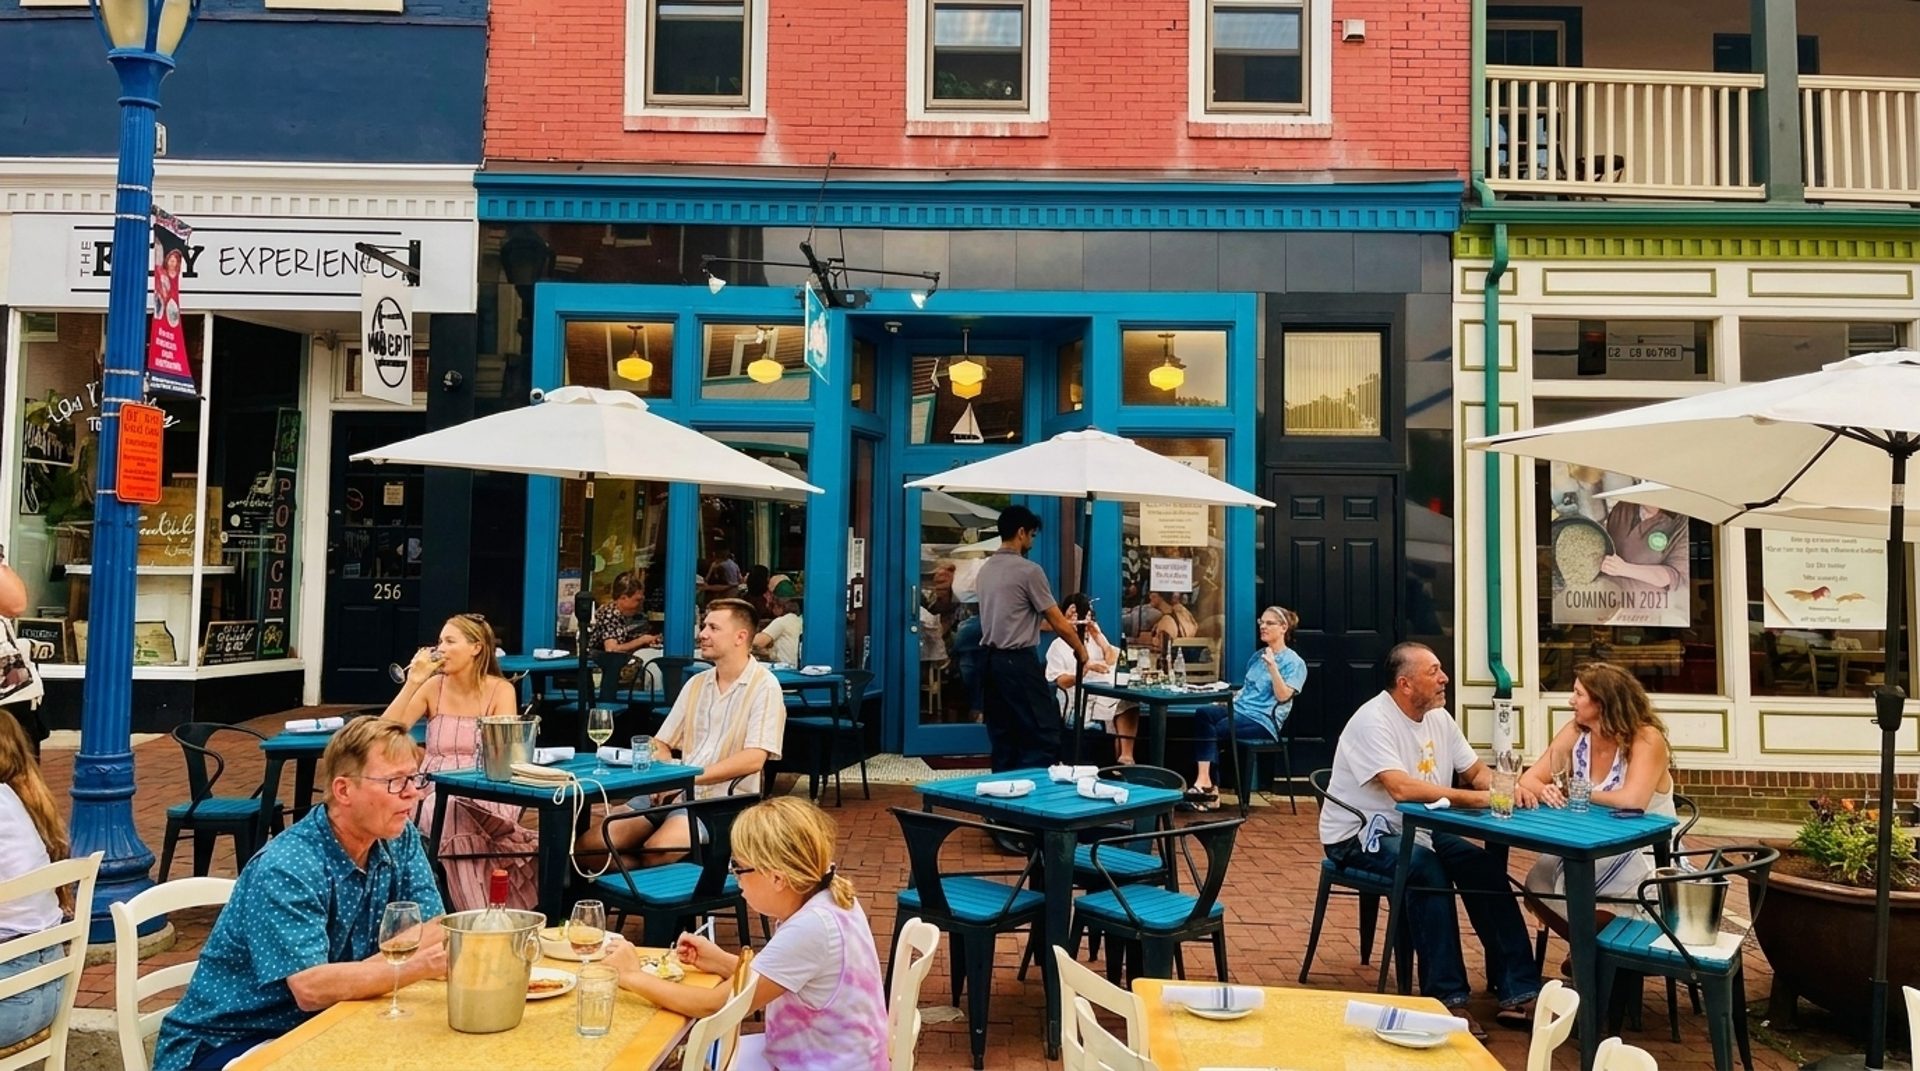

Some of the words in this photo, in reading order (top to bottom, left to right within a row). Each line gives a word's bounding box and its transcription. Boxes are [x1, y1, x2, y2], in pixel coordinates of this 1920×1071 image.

[80, 241, 91, 277] THE
[373, 583, 402, 600] 256
[1565, 590, 1617, 609] COMING
[1621, 591, 1635, 609] IN
